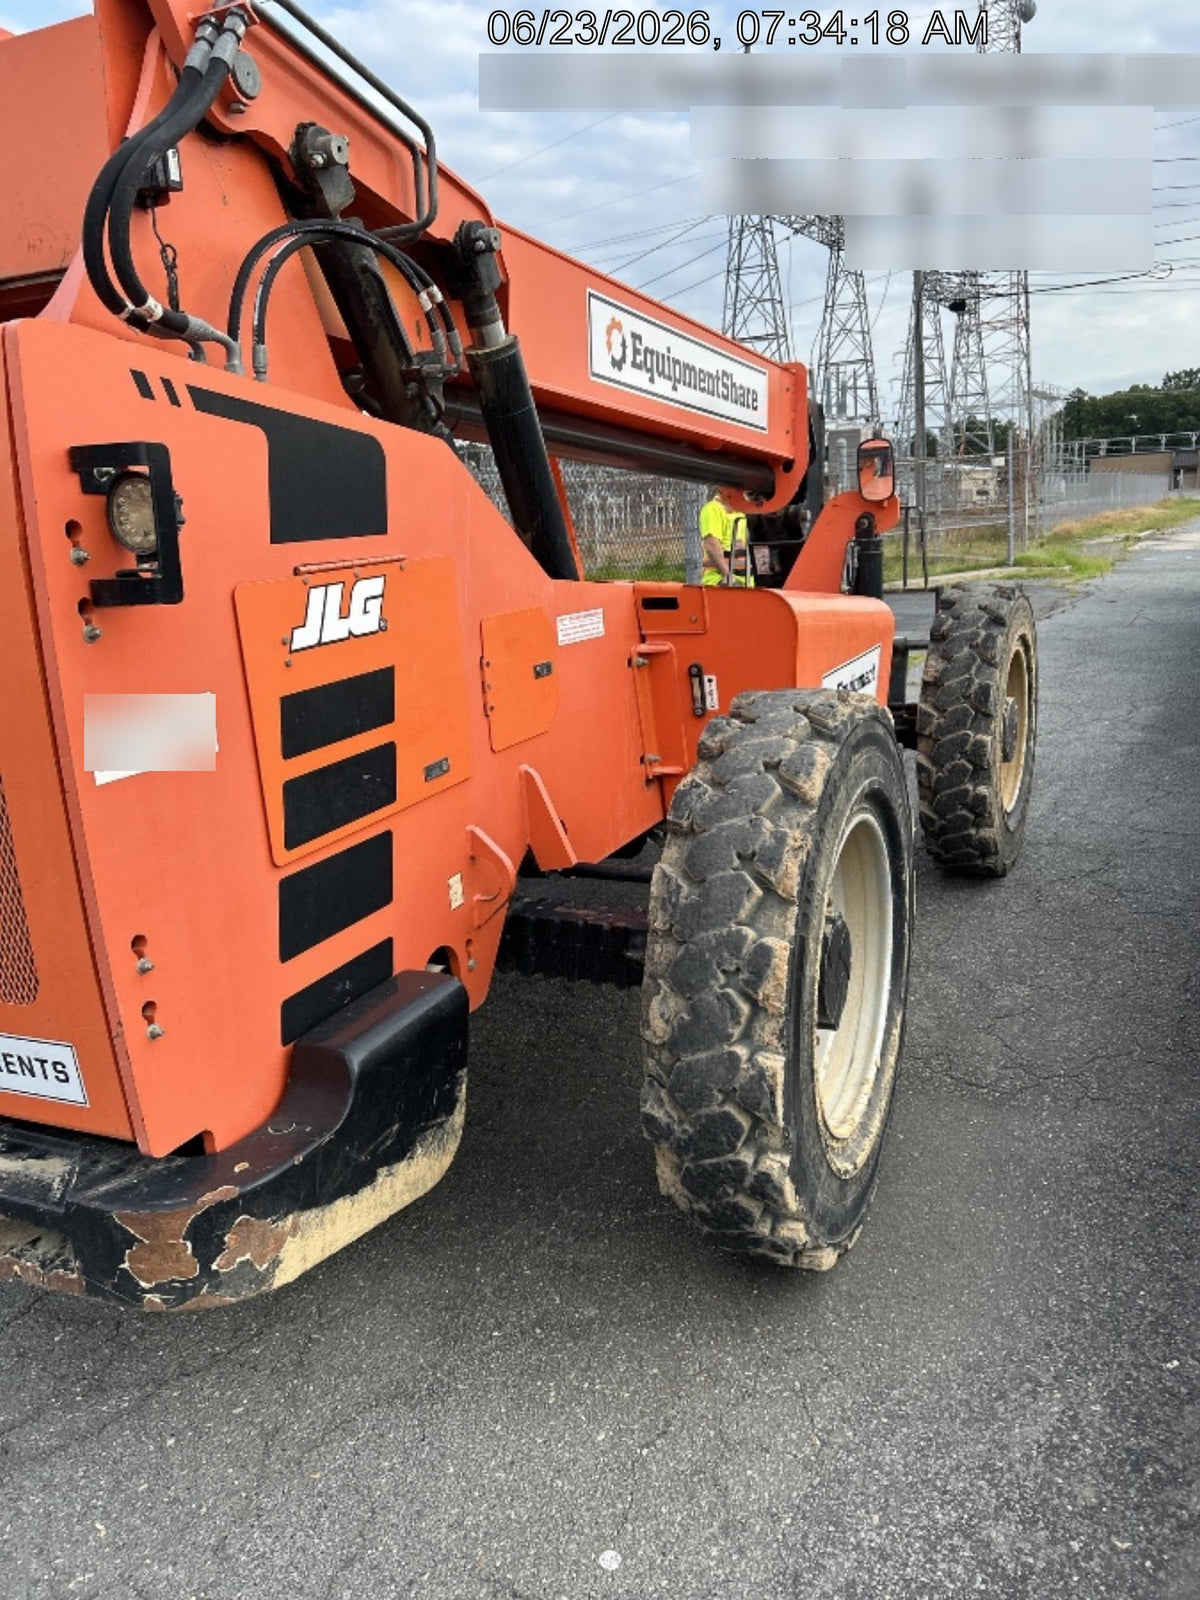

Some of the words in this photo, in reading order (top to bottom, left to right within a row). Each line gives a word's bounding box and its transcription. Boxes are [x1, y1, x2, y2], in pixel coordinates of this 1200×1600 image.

[630, 331, 759, 412] EquipmentShare
[289, 574, 387, 654] JLG
[0, 1052, 70, 1083] ENTS
